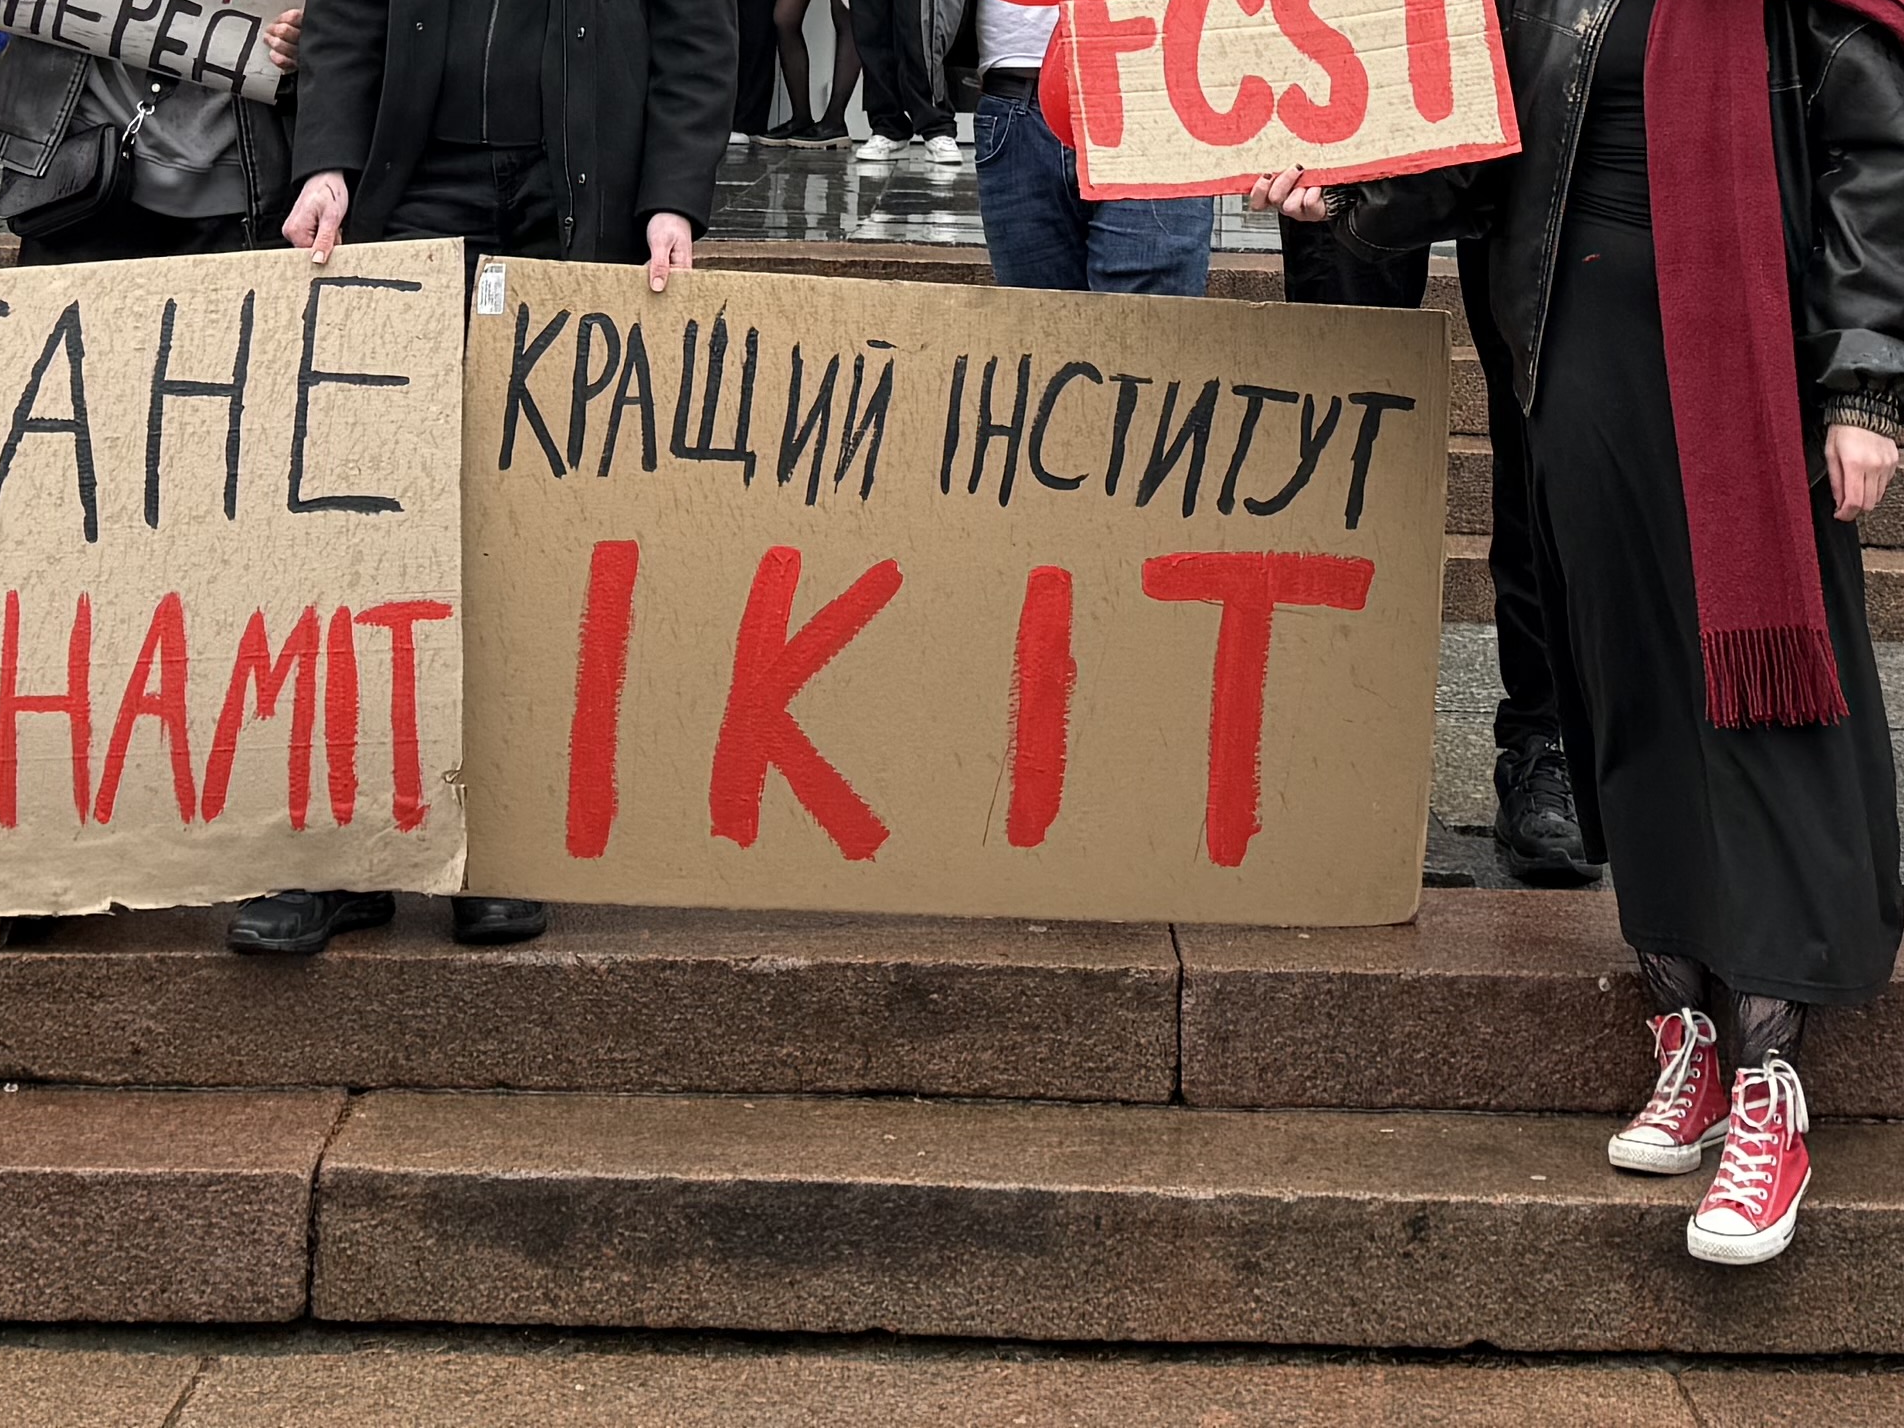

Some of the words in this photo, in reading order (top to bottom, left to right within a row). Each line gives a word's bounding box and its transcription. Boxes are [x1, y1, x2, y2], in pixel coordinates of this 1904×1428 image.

[498, 299, 897, 507] КРАЩИЙ
[940, 352, 1418, 531] ІНСТИТУТ
[565, 539, 1378, 869] ІКІТ
